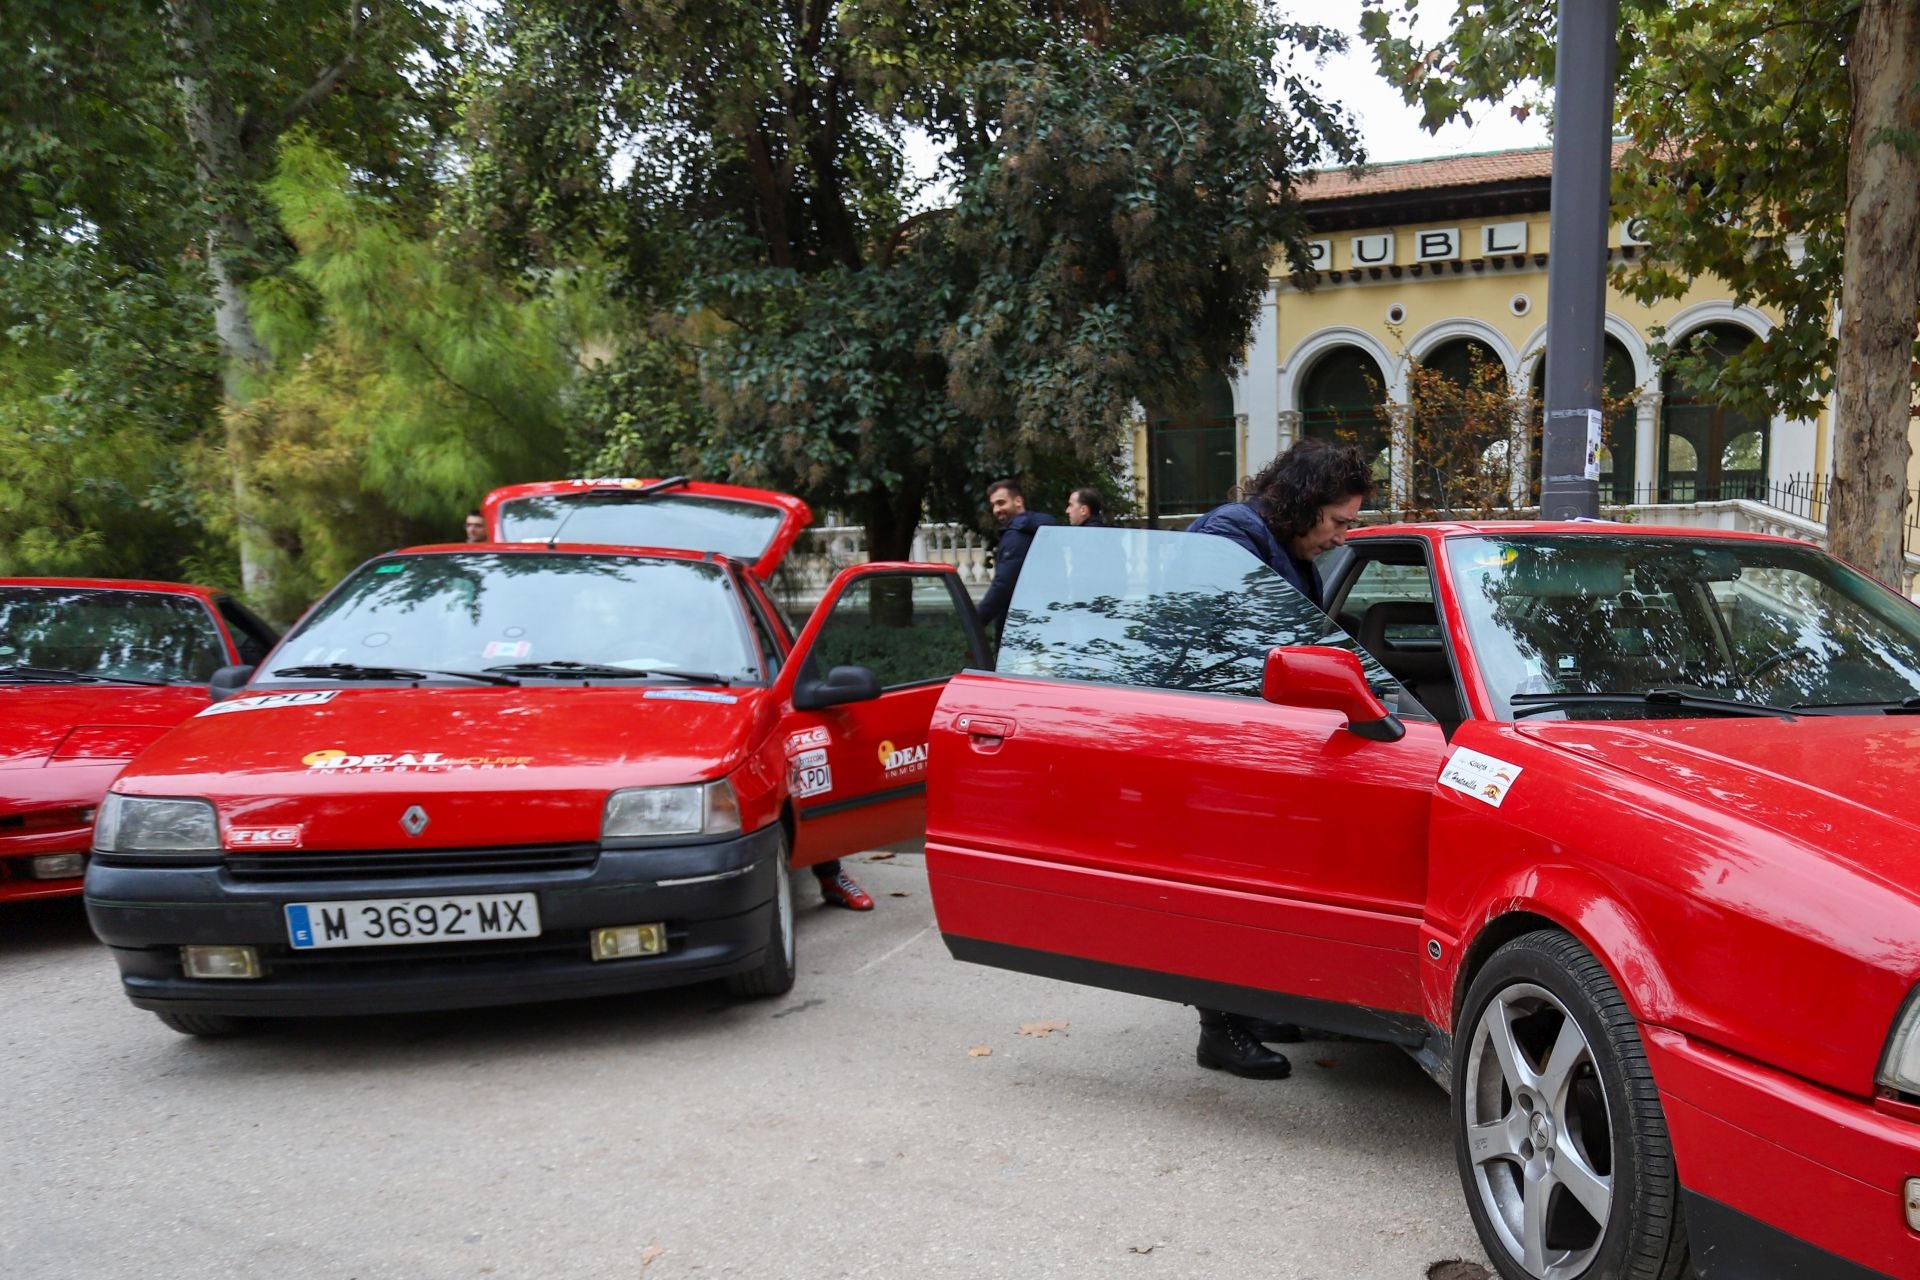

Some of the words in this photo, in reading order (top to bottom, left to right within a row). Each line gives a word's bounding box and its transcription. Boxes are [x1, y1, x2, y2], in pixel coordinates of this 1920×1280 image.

[305, 764, 528, 776] INMOBILIARIA
[229, 828, 295, 841] FKG
[361, 903, 466, 939] 3692
[477, 900, 528, 934] MX
[296, 930, 309, 941] E
